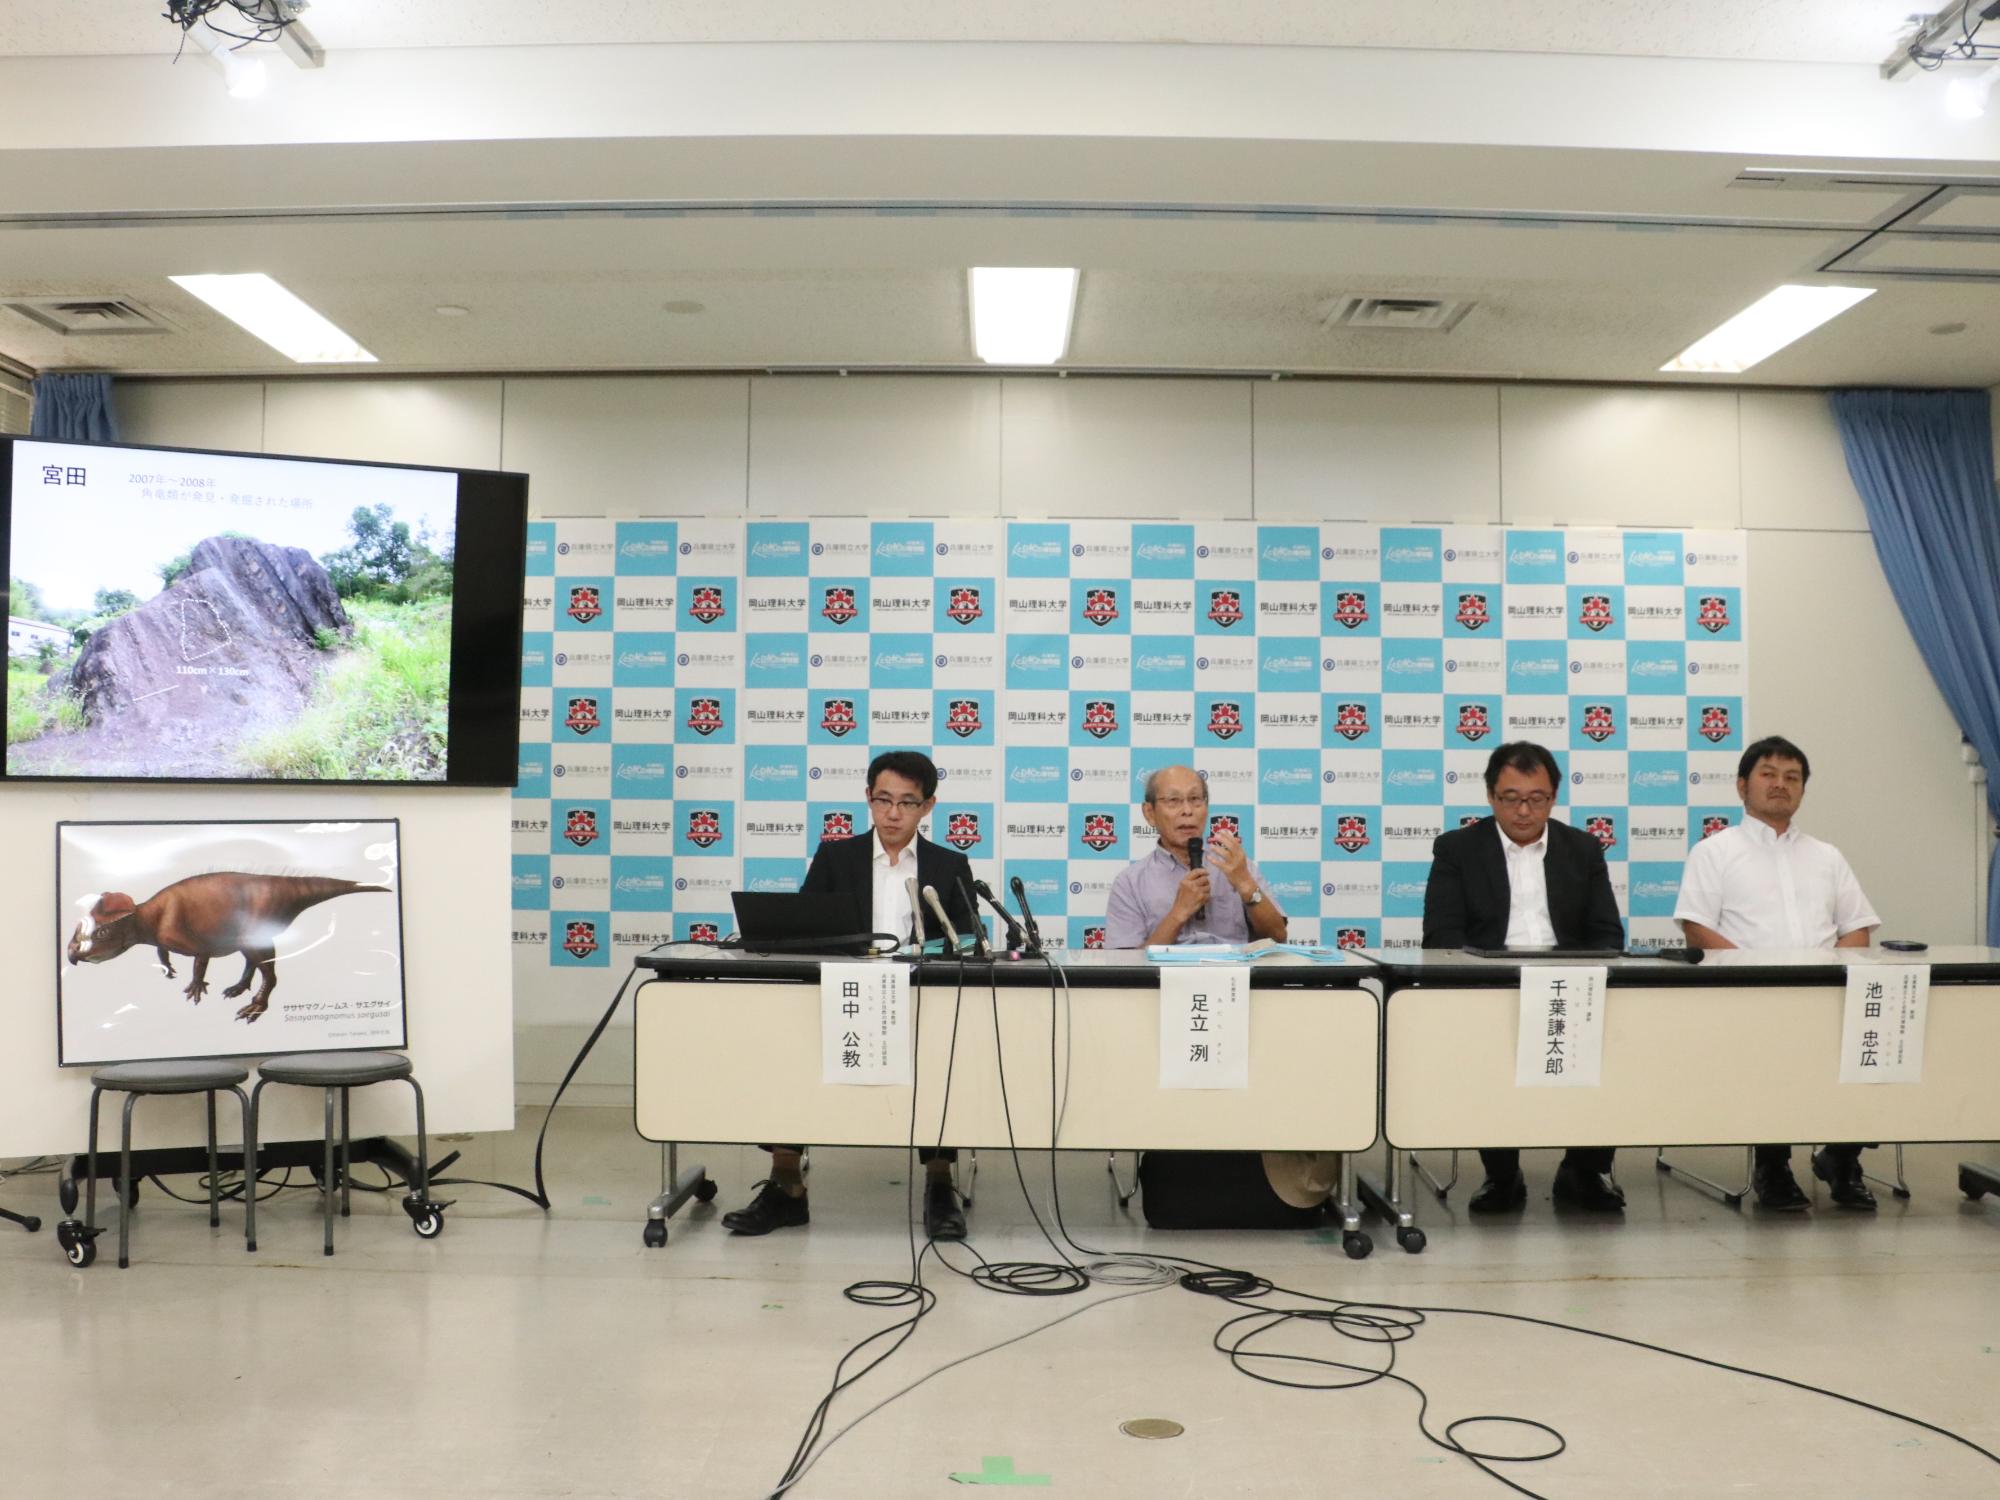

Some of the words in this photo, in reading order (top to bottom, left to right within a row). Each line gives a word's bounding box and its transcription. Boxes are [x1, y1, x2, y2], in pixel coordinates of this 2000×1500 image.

[42, 465, 86, 487] 宮田
[617, 597, 674, 608] 岡山理科大学
[748, 598, 806, 609] 岡山理科大学
[872, 598, 931, 609] 岡山理科大学
[1009, 599, 1067, 610] 岡山理科大学
[1134, 600, 1191, 611] 岡山理科大学
[1260, 602, 1318, 613] 岡山理科大学
[1384, 603, 1440, 614] 岡山理科大学
[1508, 605, 1564, 616] 岡山理科大学
[1628, 606, 1682, 617] 岡山理科大学
[615, 708, 672, 719] 岡山理科大学
[747, 710, 805, 720] 岡山理科大学
[871, 710, 930, 721] 岡山理科大学
[1008, 711, 1066, 722] 岡山理科大学
[1133, 712, 1191, 723] 岡山理科大学
[1260, 713, 1318, 724] 岡山理科大学
[1384, 714, 1440, 725] 岡山理科大学
[1509, 716, 1565, 726] 岡山理科大学
[1630, 716, 1684, 726] 岡山理科大学
[613, 821, 671, 831] 岡山理科大学
[746, 822, 804, 833] 岡山理科大学
[1007, 824, 1065, 835] 岡山理科大学
[1260, 826, 1318, 837] 岡山理科大学
[1384, 827, 1441, 837] 岡山理科大学
[1631, 827, 1685, 837] 岡山理科大学
[612, 932, 670, 943] 岡山理科大学
[1631, 938, 1685, 948] 岡山理科大学
[842, 981, 860, 1019] 田中
[1864, 981, 1883, 1018] 池田
[1190, 993, 1209, 1032] 足立
[1545, 979, 1568, 1075] 千葉謙太郎
[842, 1031, 861, 1068] 公教
[1860, 1029, 1880, 1067] 忠広
